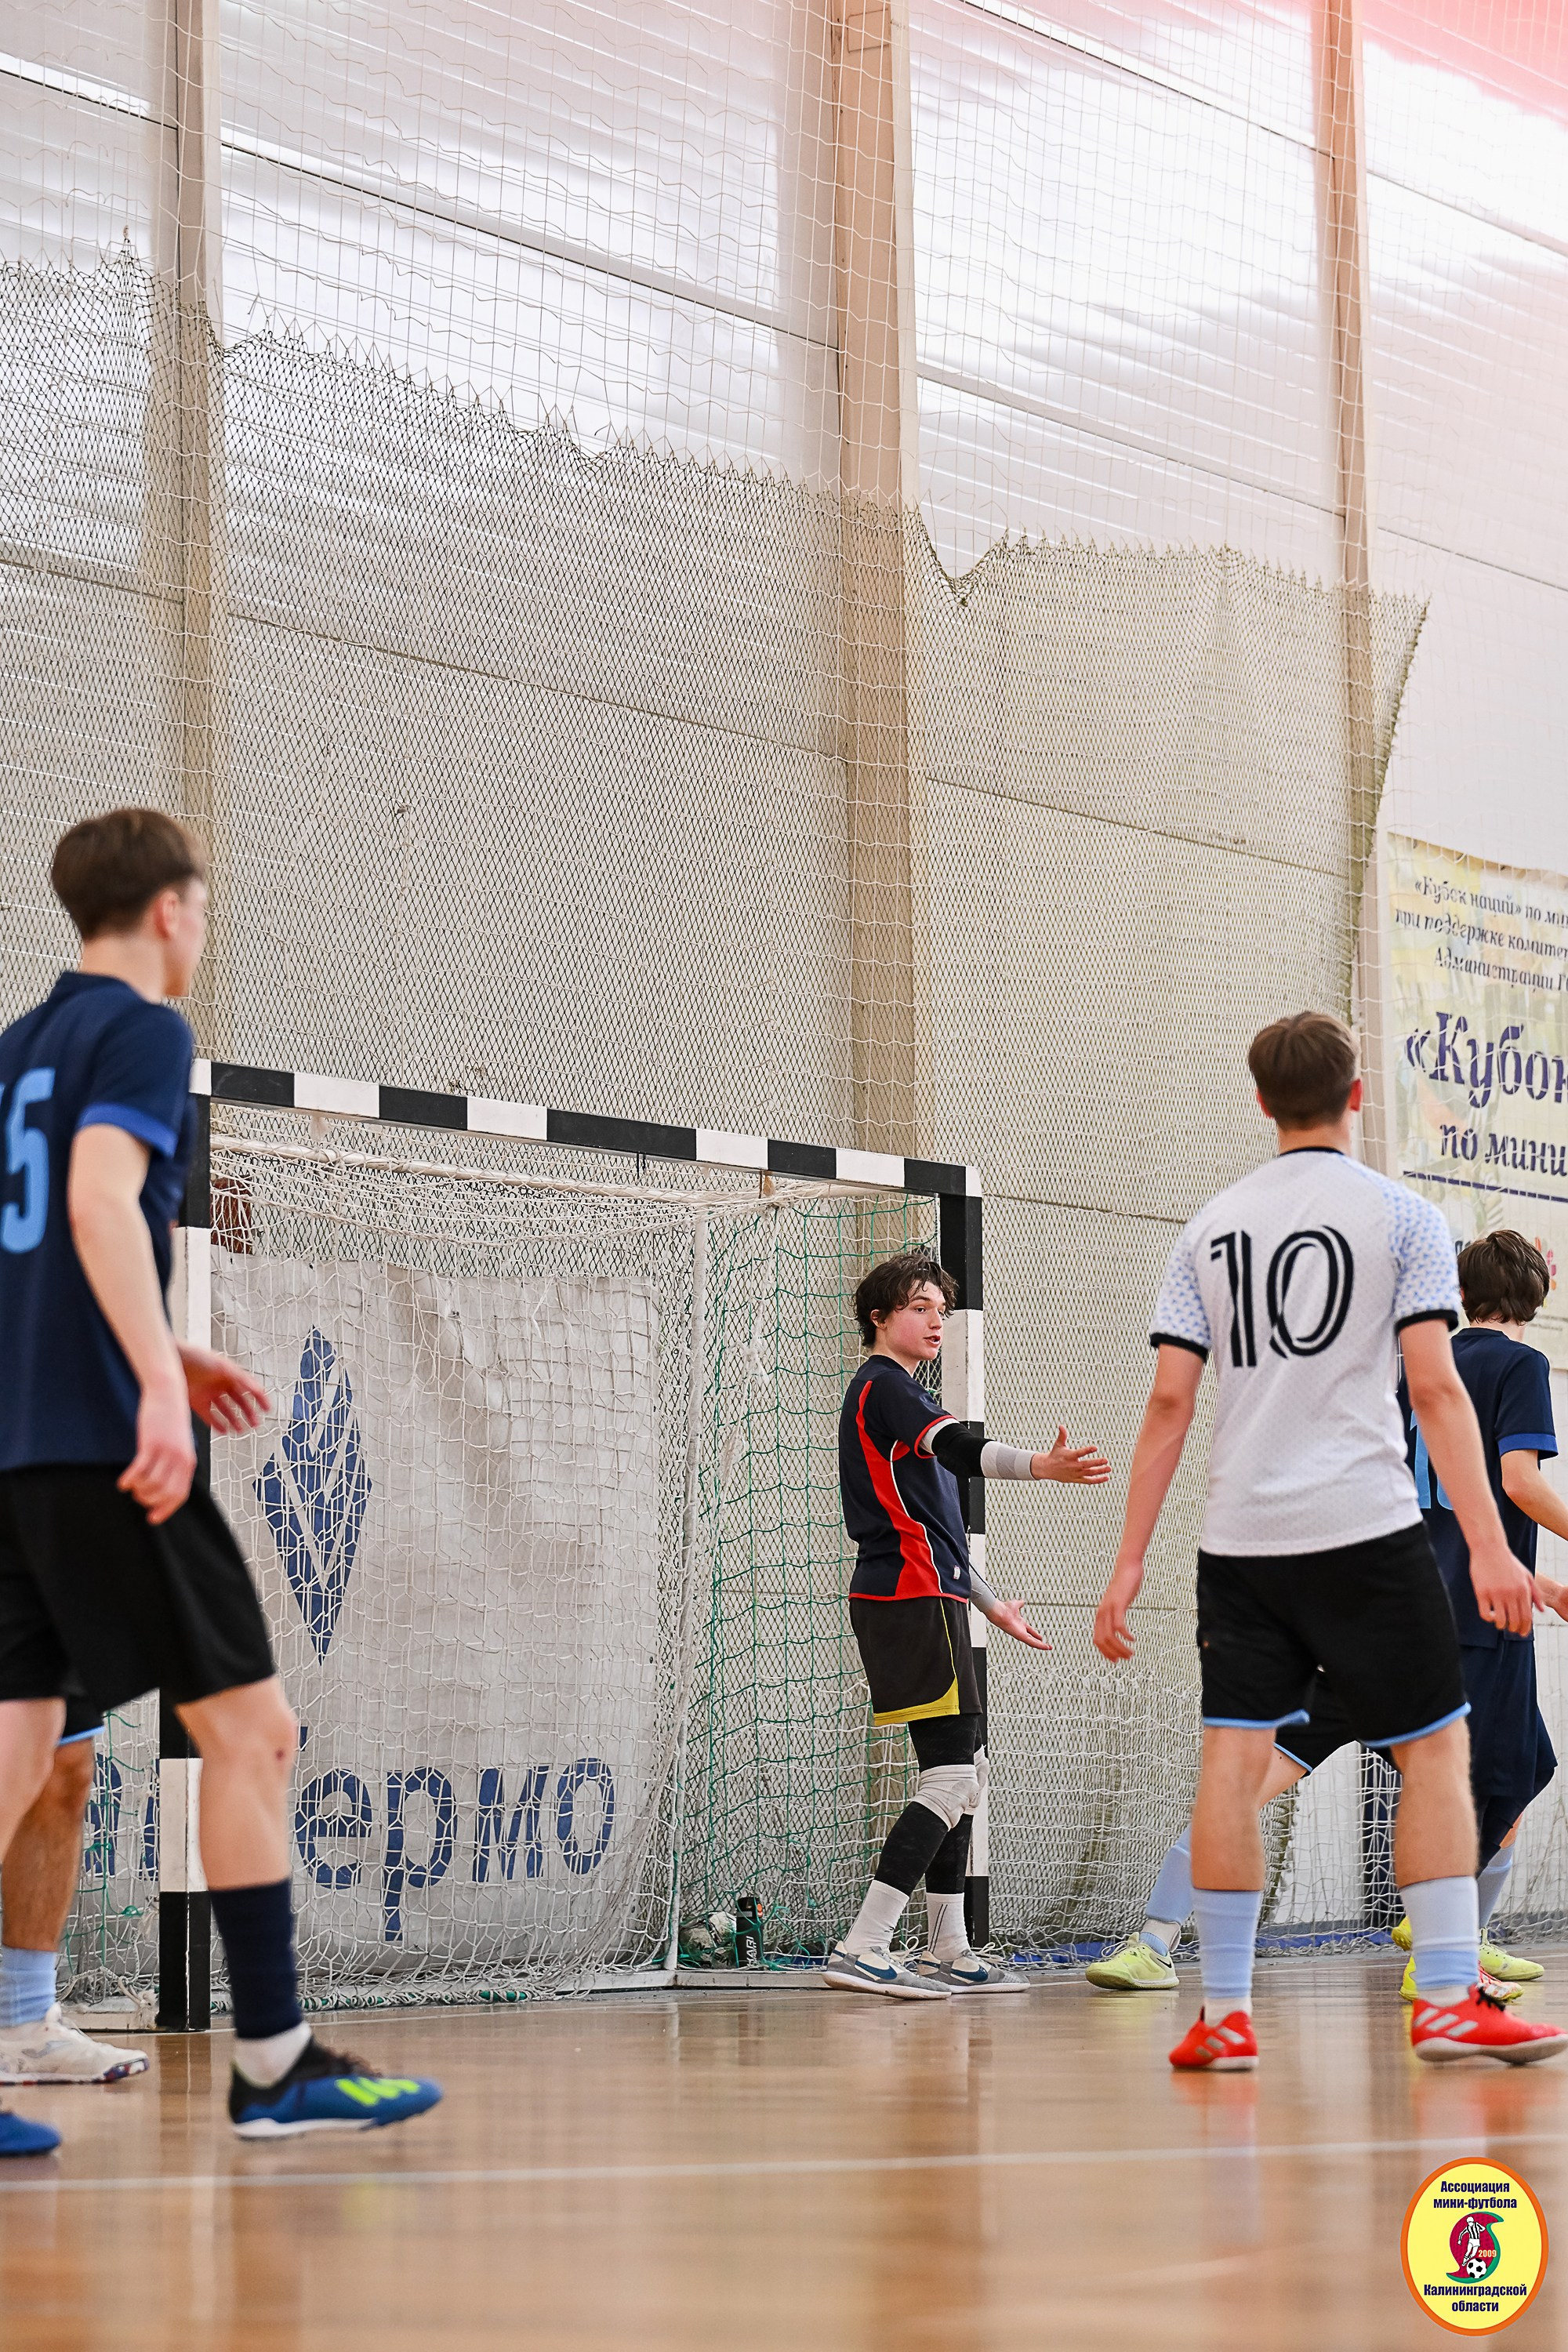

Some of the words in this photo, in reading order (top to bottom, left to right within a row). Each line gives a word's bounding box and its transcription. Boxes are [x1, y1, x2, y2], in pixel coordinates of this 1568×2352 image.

[1414, 876, 1467, 904] «Кубок
[1470, 892, 1522, 916] наций»
[1526, 905, 1541, 923] по
[1396, 909, 1420, 928] при
[1425, 913, 1504, 946] поддержке
[1434, 947, 1554, 993] Администрации
[0, 1067, 56, 1253] 5
[1439, 1124, 1478, 1160] по
[1484, 1132, 1568, 1178] мини
[1210, 1225, 1354, 1368] 10
[295, 1725, 615, 1942] ермо
